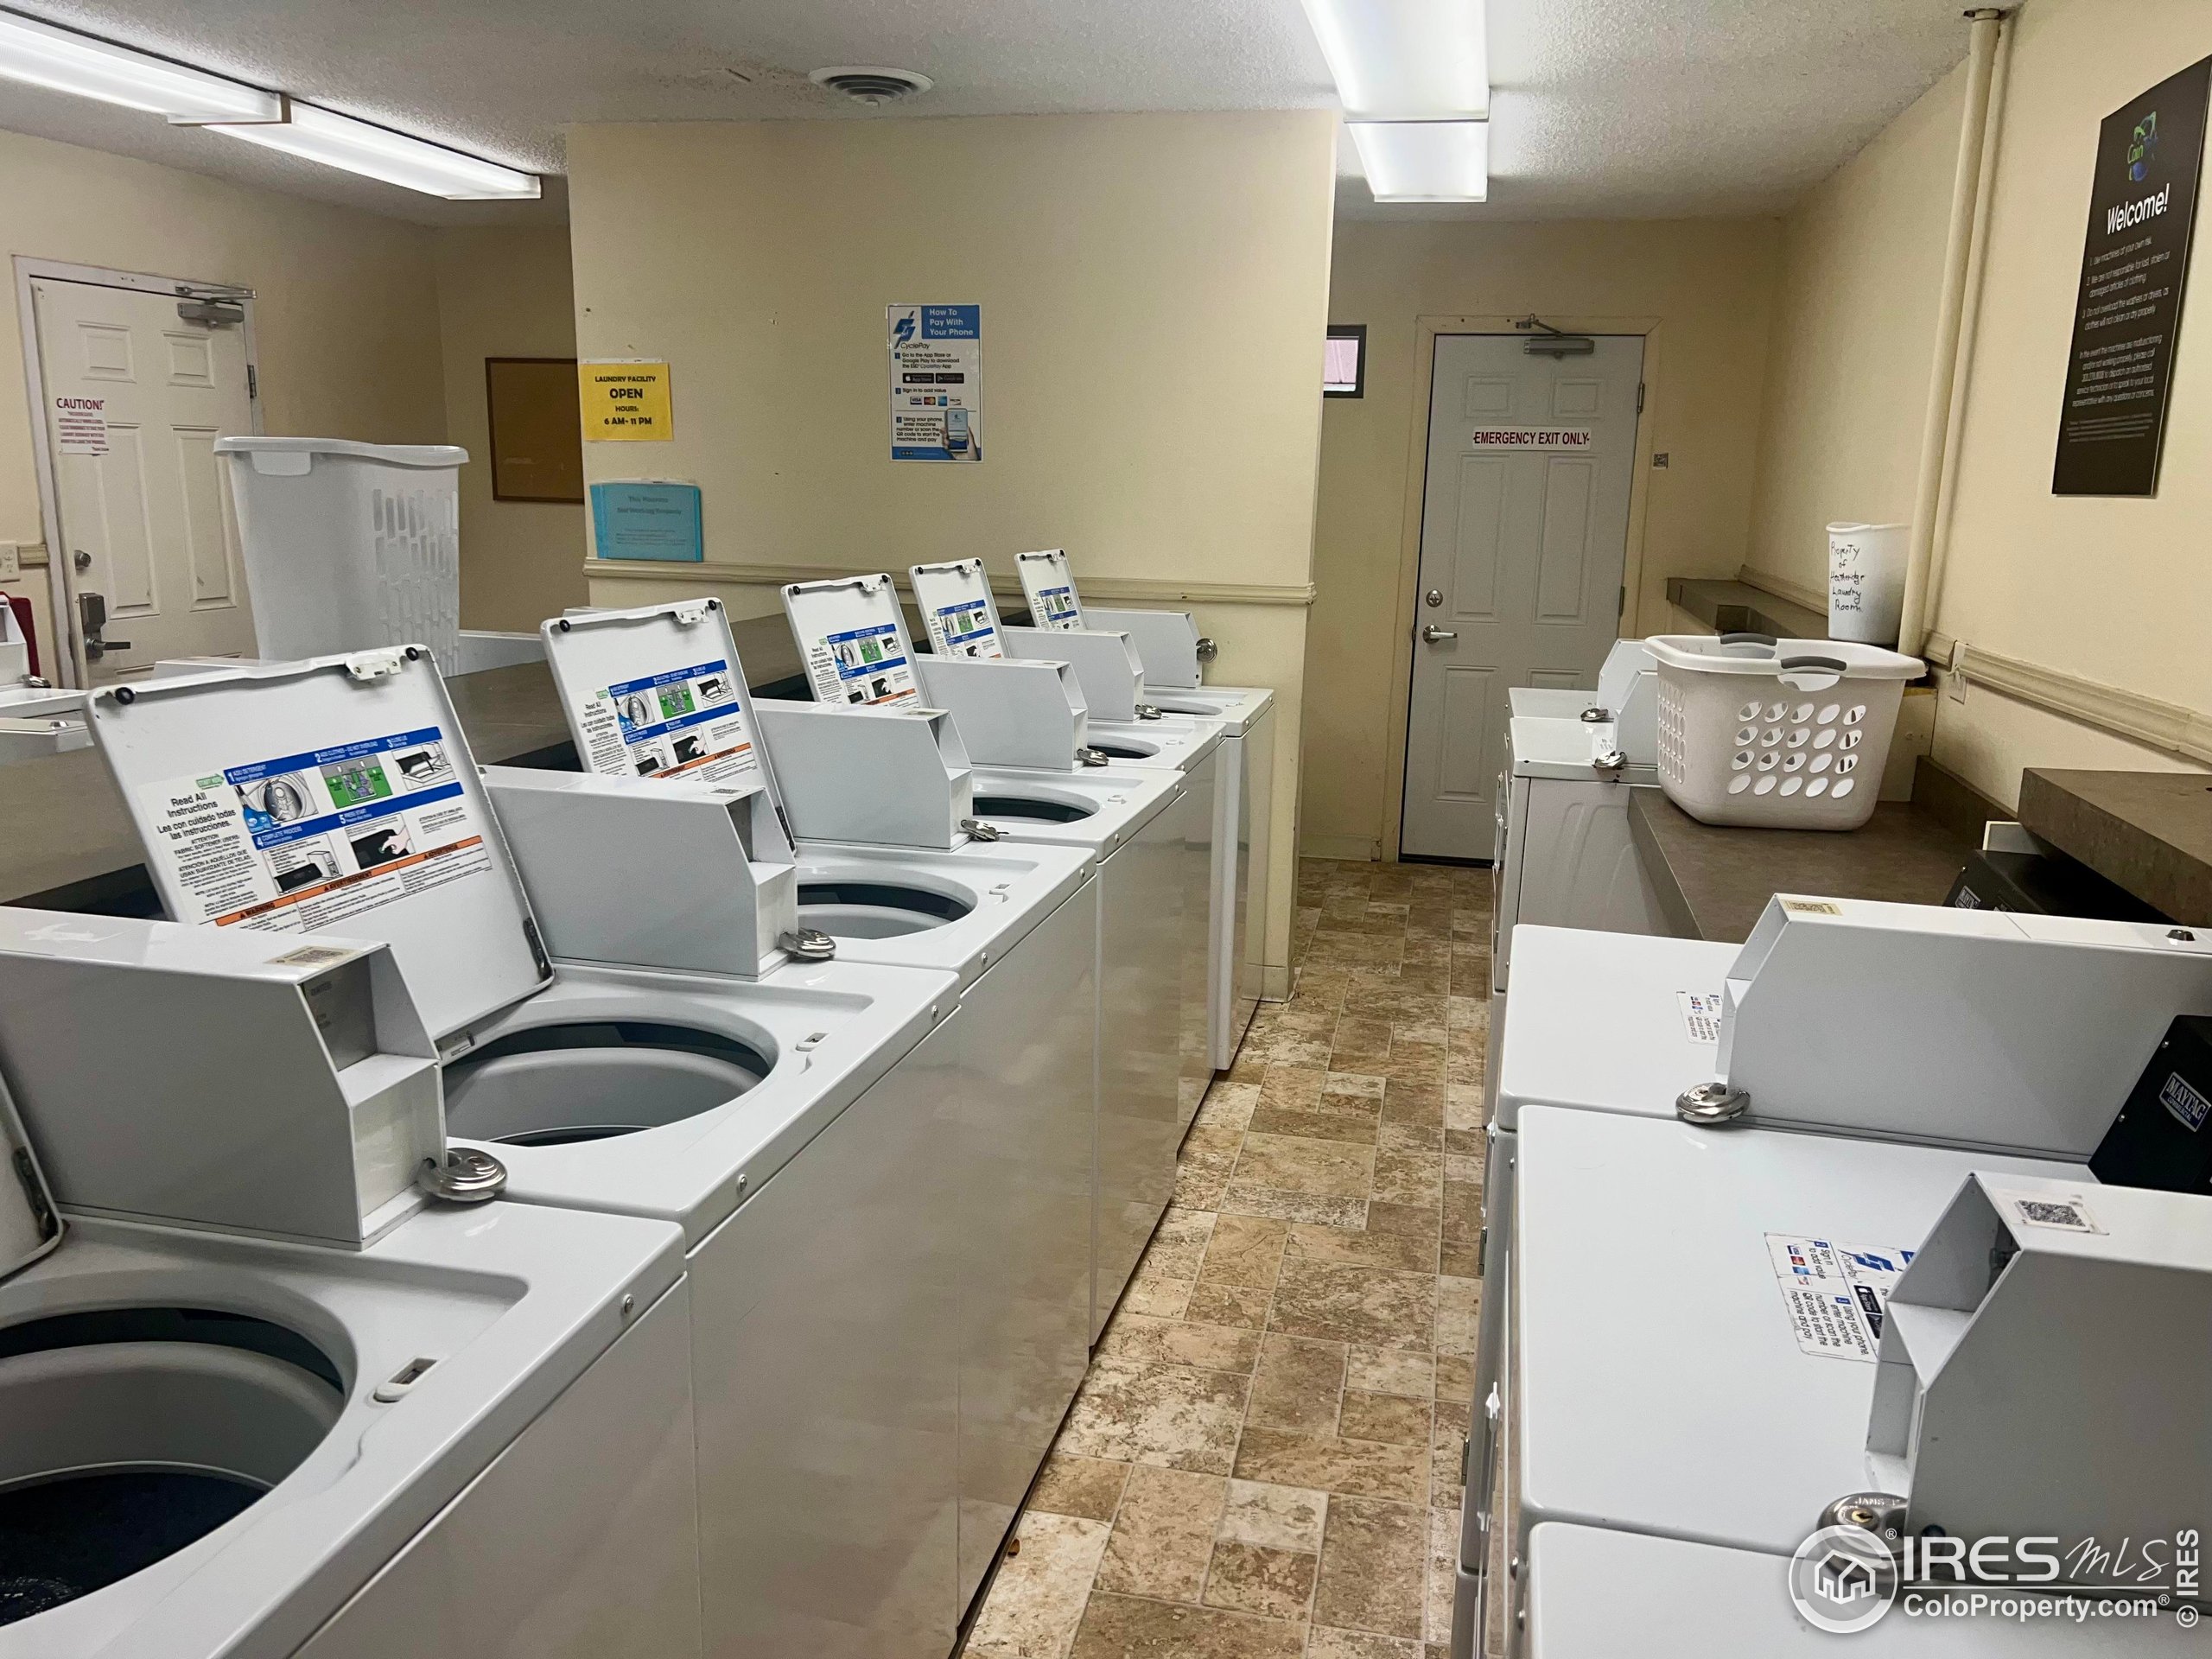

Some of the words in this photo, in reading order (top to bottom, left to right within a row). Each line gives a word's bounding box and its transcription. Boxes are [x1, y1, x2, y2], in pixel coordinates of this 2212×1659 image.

[2107, 182, 2170, 235] Welcome!
[610, 389, 643, 398] OPEN
[1474, 432, 1536, 443] EMERGENCY
[1539, 433, 1560, 444] EXIT
[1562, 433, 1588, 444] ONLY
[1839, 559, 1847, 568] of
[1833, 588, 1861, 604] Laundry
[387, 739, 394, 747] 3
[315, 753, 321, 762] 2
[228, 772, 235, 782] 1
[171, 795, 194, 807] Read
[195, 792, 207, 801] All
[167, 801, 218, 818] Instructions
[156, 825, 172, 834] Lea
[174, 822, 188, 830] con
[188, 815, 216, 826] cuidado
[217, 810, 236, 818] todas
[339, 814, 346, 823] 5
[194, 839, 221, 849] SOFTENER
[257, 837, 264, 846] 4
[2166, 1077, 2206, 1120] MAYTAG
[1811, 1254, 1821, 1264] add
[1821, 1249, 1833, 1259] Sign
[1815, 1265, 1827, 1279] value
[1790, 1291, 1806, 1314] machine
[1802, 1292, 1813, 1301] QR
[1806, 1301, 1817, 1316] code
[1815, 1294, 1832, 1315] number
[1830, 1305, 1843, 1318] enter
[1842, 1306, 1854, 1320] Using
[1799, 1316, 1809, 1326] and
[1800, 1328, 1814, 1340] pay
[1814, 1324, 1826, 1336] start
[1826, 1323, 1839, 1337] scan
[1836, 1319, 1853, 1344] machine
[1847, 1322, 1861, 1334] your
[1817, 1338, 1828, 1346] the
[1832, 1338, 1842, 1347] the
